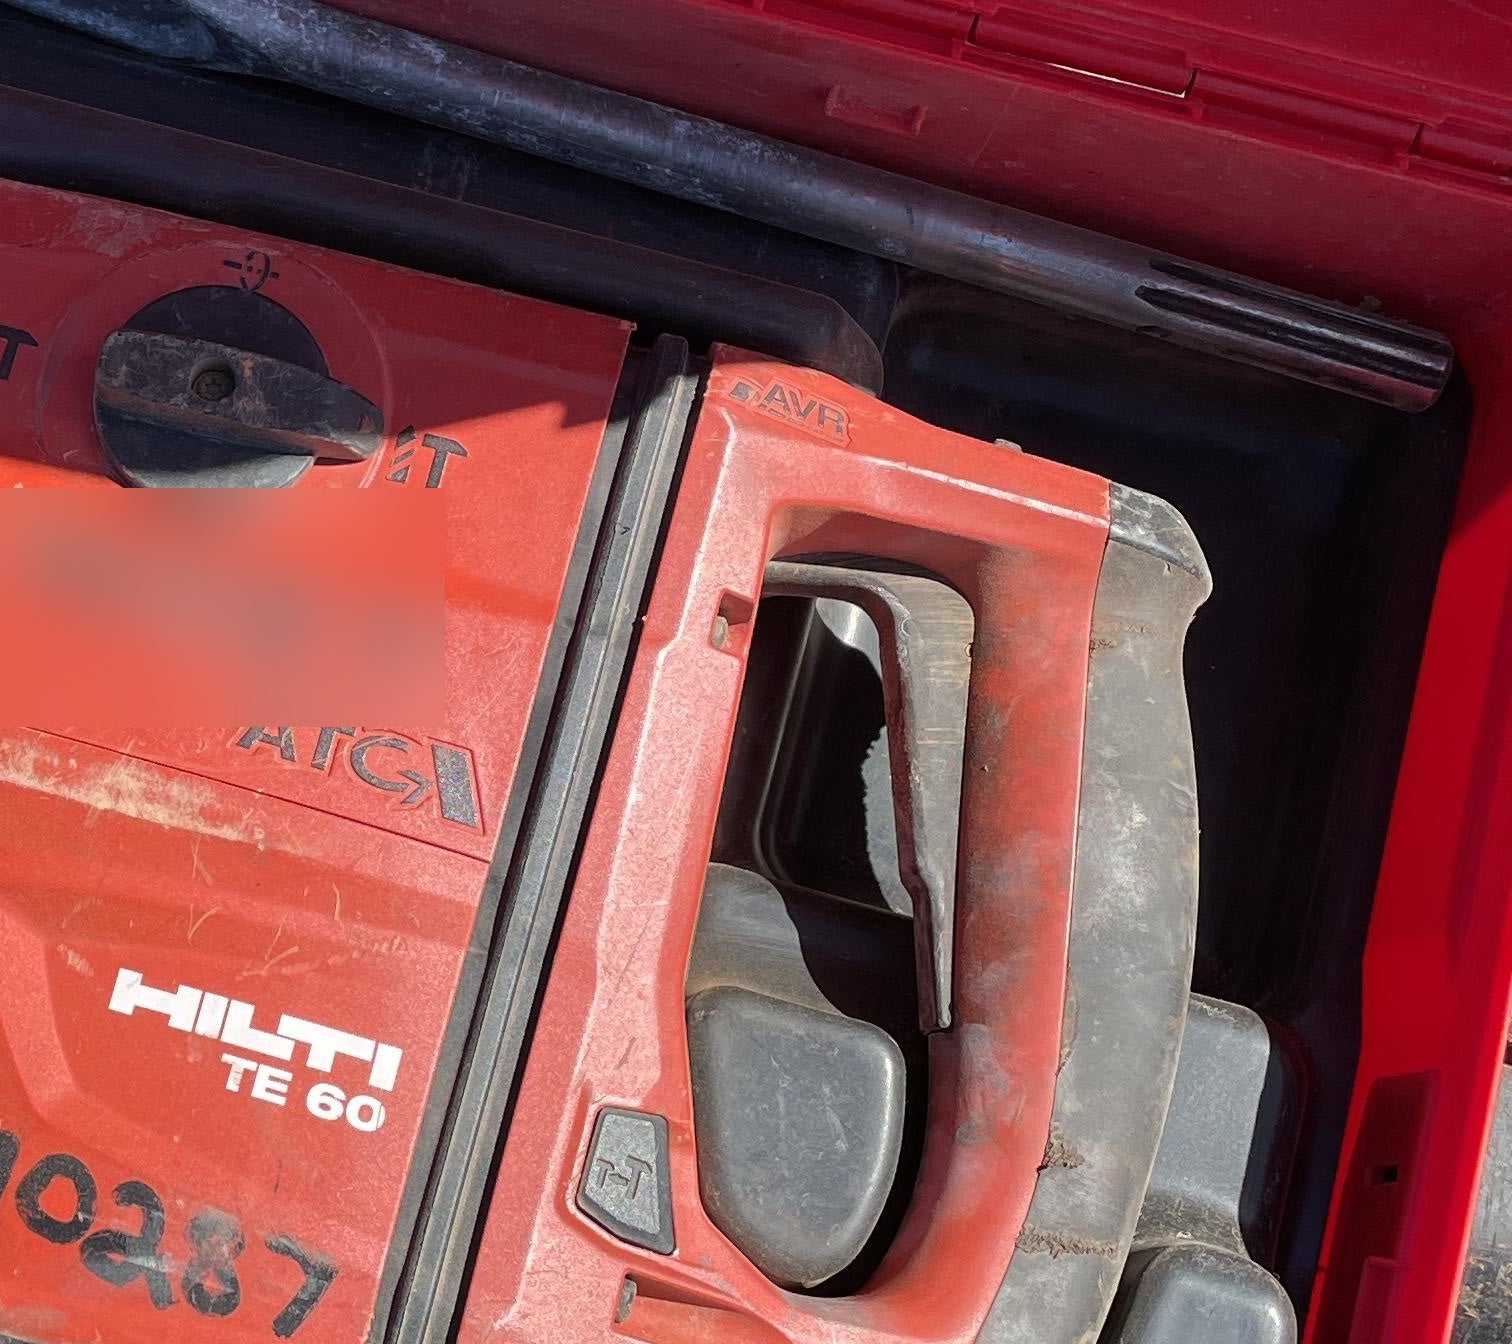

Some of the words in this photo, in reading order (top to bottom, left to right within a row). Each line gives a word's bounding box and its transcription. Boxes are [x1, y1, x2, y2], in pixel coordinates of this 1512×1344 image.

[763, 383, 845, 434] AVR
[108, 967, 403, 1092] HILTI
[220, 1052, 294, 1106] TE
[305, 1081, 387, 1133] 60
